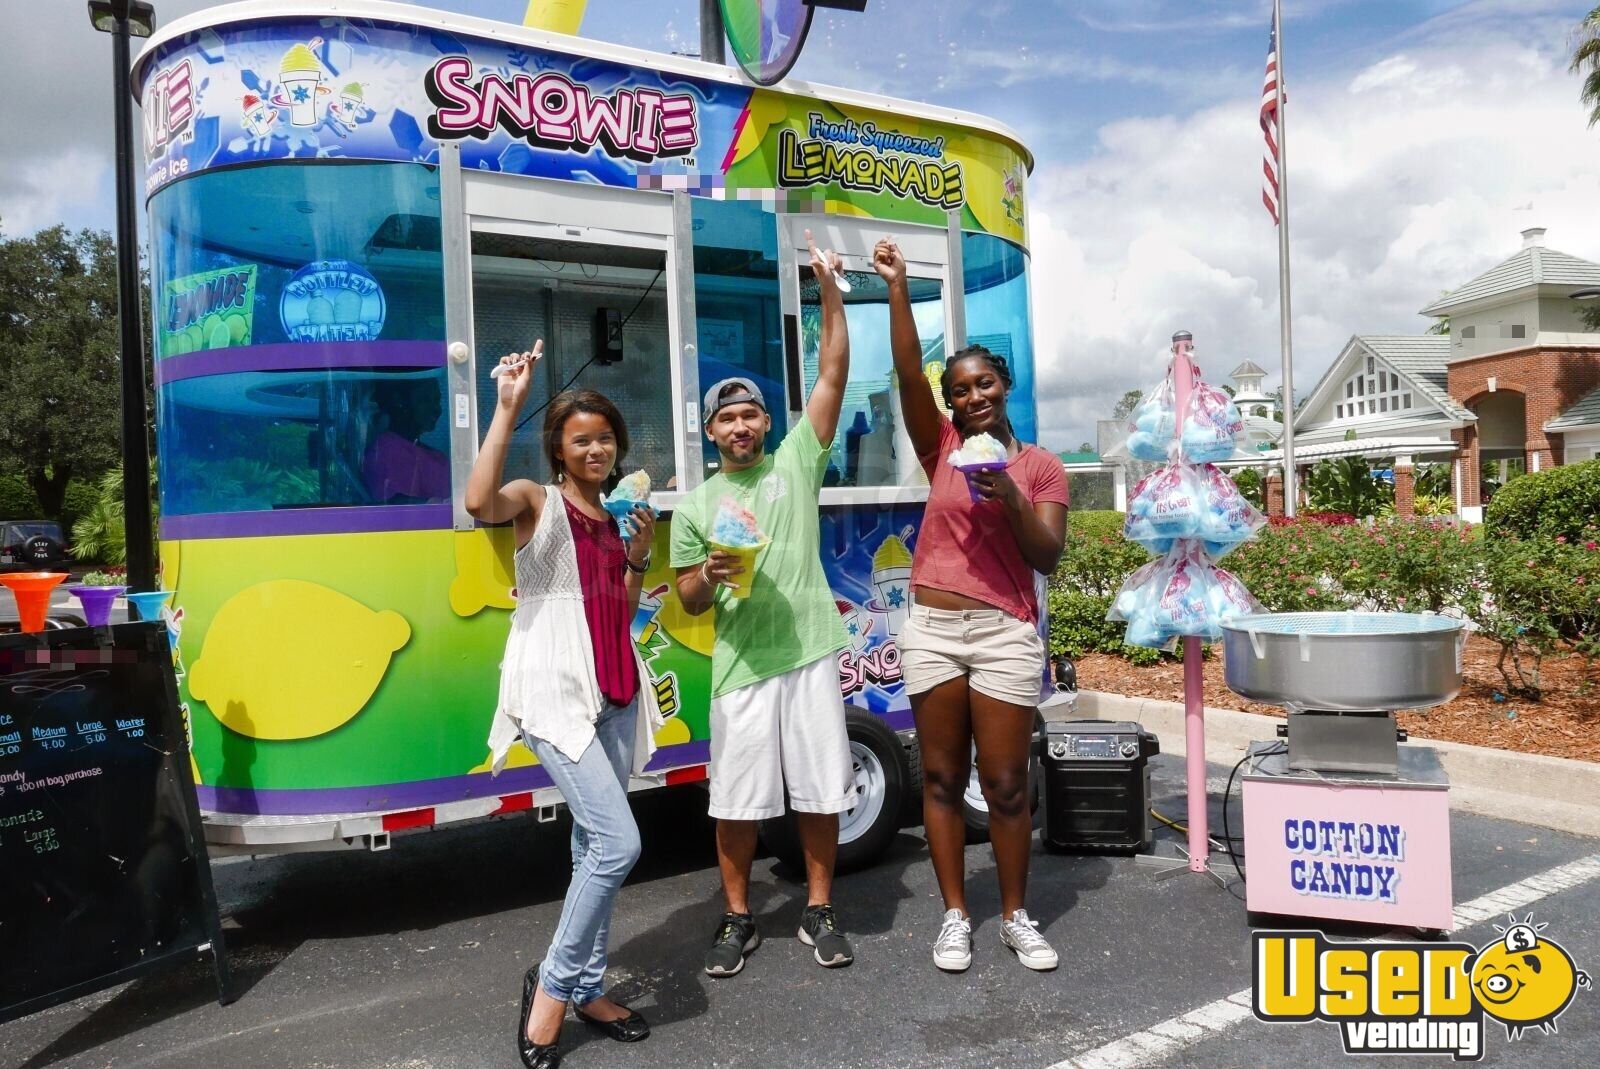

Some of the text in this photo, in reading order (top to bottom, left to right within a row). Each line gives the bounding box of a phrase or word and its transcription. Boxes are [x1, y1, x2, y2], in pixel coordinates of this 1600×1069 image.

[428, 57, 698, 160] SNOWIE
[809, 112, 944, 157] Fresh Squeezed
[170, 158, 188, 175] Ice
[681, 157, 695, 166] TM
[780, 130, 964, 210] LEMONADE
[167, 271, 250, 333] LEMONADE
[287, 271, 378, 299] BOTTLED
[837, 640, 902, 694] SNO
[0, 718, 146, 743] mall Medium Large Water
[41, 739, 66, 750] 4.00
[85, 732, 106, 745] 5.00
[126, 728, 144, 738] 1.00
[0, 769, 26, 784] andy
[46, 775, 65, 788] bag
[65, 766, 103, 783] purchase
[1284, 818, 1402, 859] COTTON
[1290, 859, 1397, 901] CANDY
